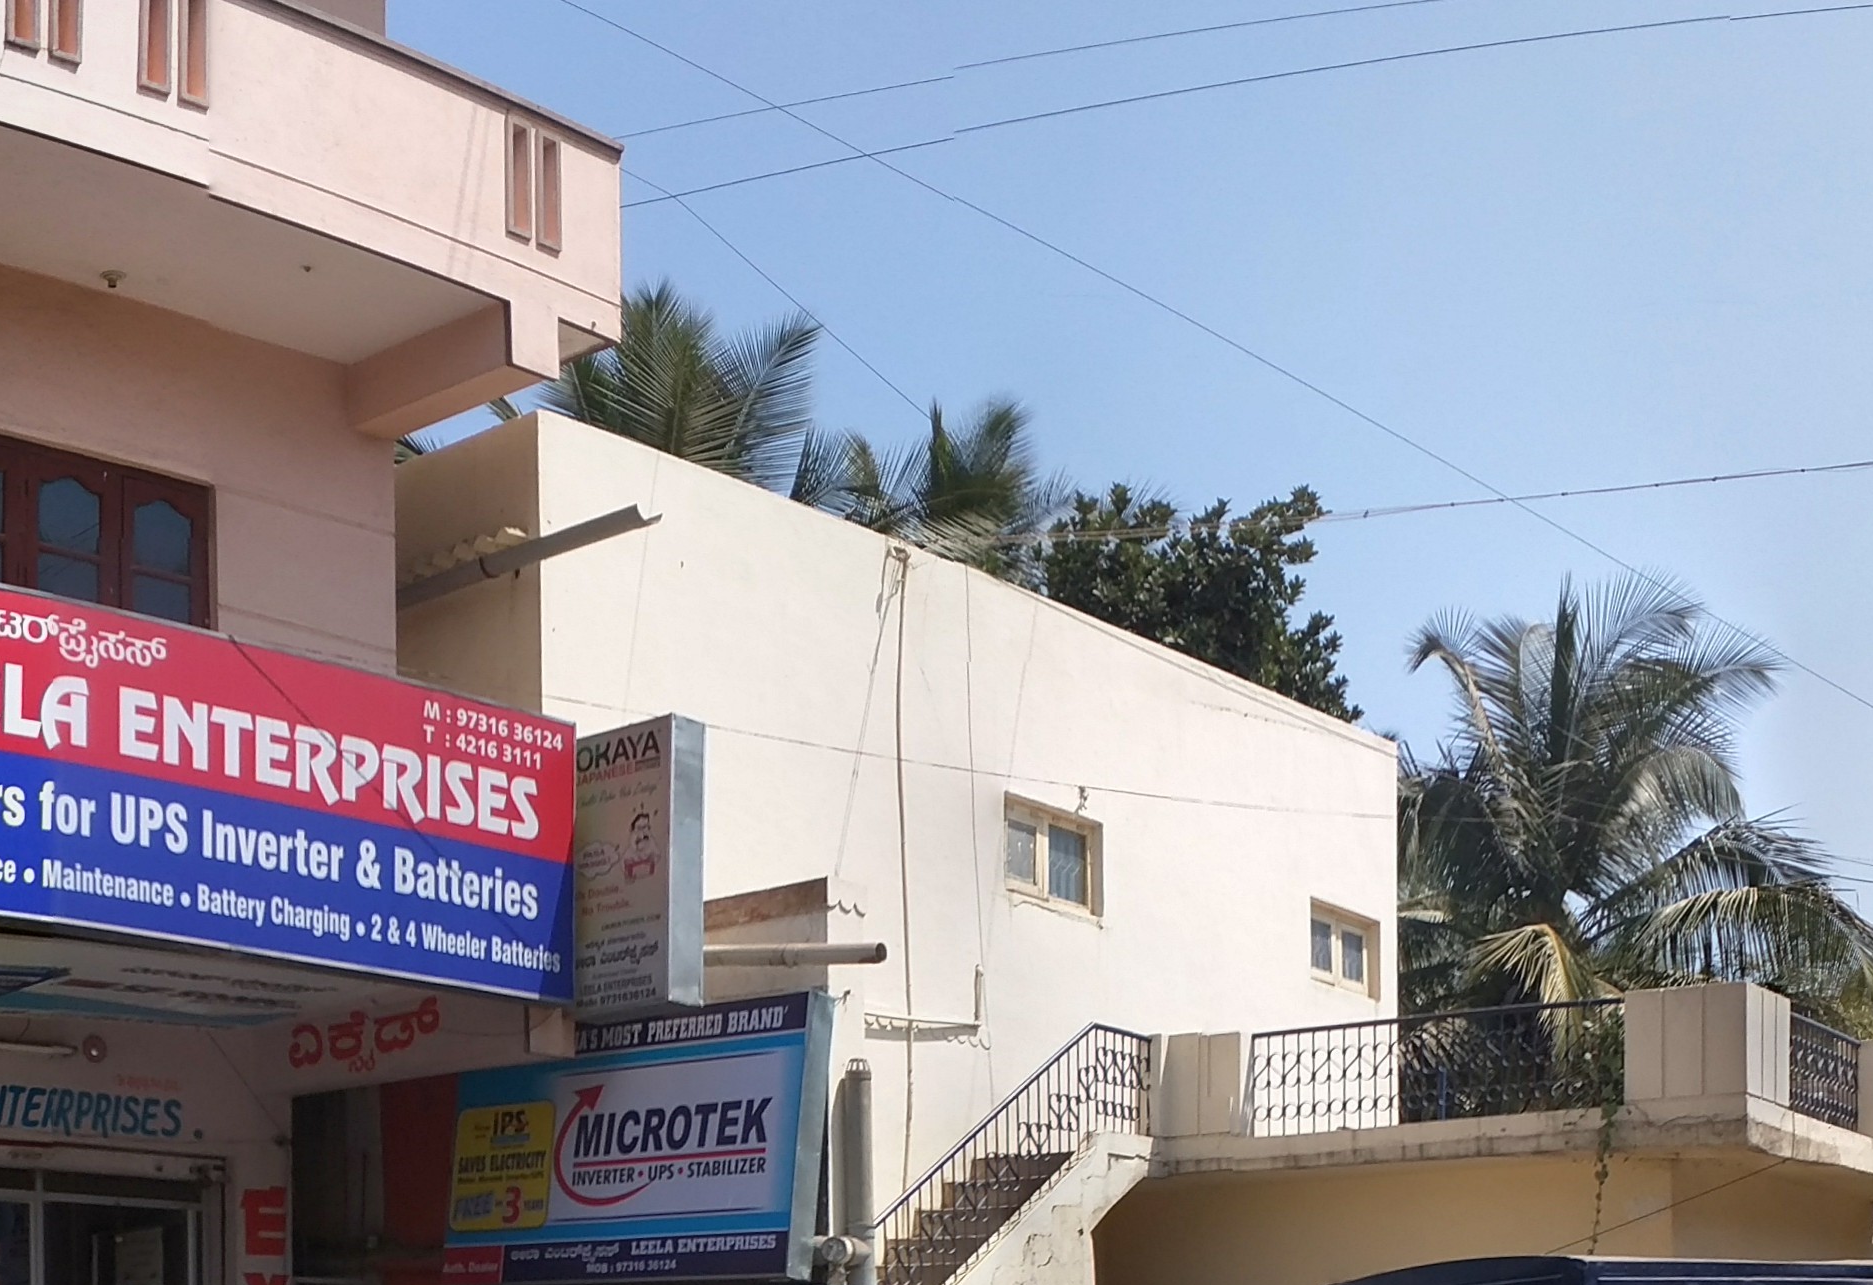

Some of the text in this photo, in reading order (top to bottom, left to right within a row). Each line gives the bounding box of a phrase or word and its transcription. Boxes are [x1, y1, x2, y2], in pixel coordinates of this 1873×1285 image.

[422, 699, 564, 752] M 97316 36124
[422, 724, 543, 770] T 4216 3111
[117, 685, 540, 842] ENTERPRISES
[577, 730, 660, 773] OKAYA
[39, 780, 97, 838] for
[110, 791, 189, 855] UPS
[201, 809, 344, 883] Inverter
[355, 838, 382, 891] &
[393, 845, 540, 921] Batteries
[41, 858, 175, 909] Maintenance
[197, 883, 267, 928] Battery
[271, 894, 351, 943] Charging
[370, 917, 383, 942] 2
[387, 920, 401, 945] &
[405, 923, 417, 949] 4
[421, 921, 488, 961] Wheeler
[491, 934, 562, 974] Batteries
[602, 1013, 723, 1050] MOST PREFERRED
[573, 1095, 774, 1159] MICROTEK
[489, 1149, 545, 1170] ELECTRICITY
[572, 1156, 767, 1187] INVERTER UPS STABILIZER
[501, 1186, 522, 1225] 3
[616, 1260, 645, 1273] 97316
[647, 1259, 677, 1272] 36124
[631, 1234, 777, 1256] LEELA ENTERPRISES
